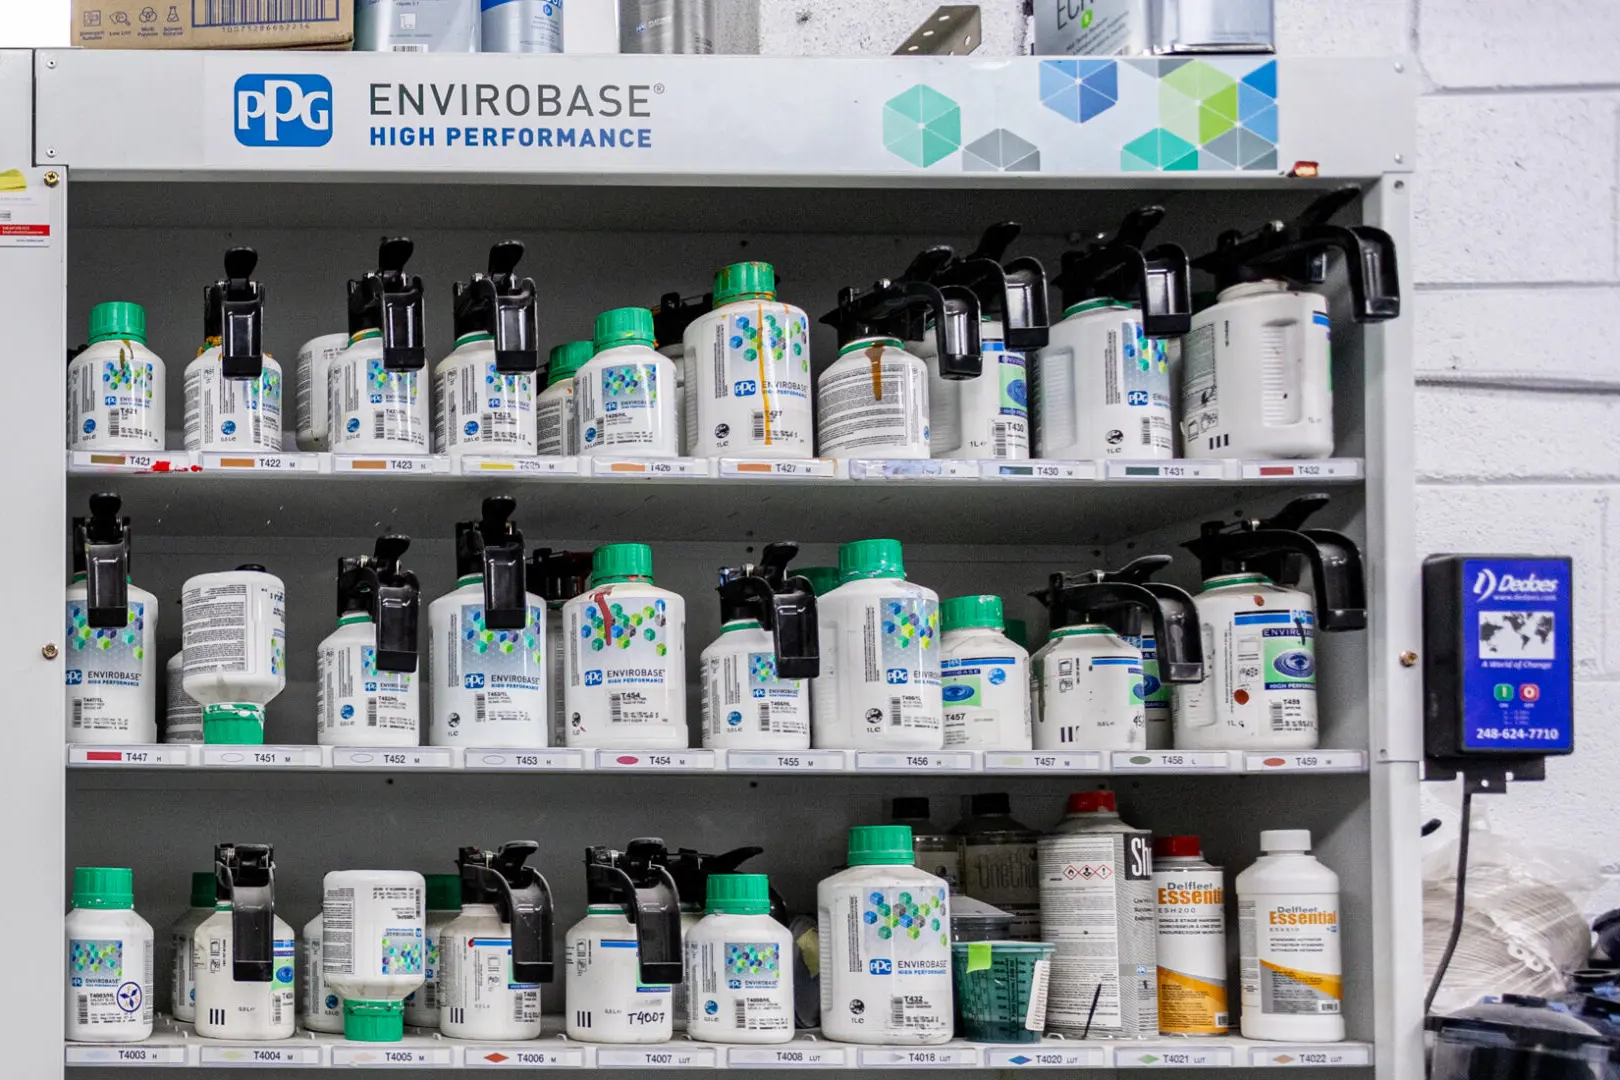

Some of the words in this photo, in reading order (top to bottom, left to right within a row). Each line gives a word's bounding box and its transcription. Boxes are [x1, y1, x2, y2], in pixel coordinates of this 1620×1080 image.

[237, 80, 329, 141] PPG
[370, 127, 435, 147] HIGH
[446, 127, 652, 149] PERFORMANCE
[129, 456, 151, 466] T421
[259, 458, 281, 468] T422
[391, 460, 412, 470] T423
[776, 464, 796, 472] T427
[1037, 466, 1059, 476] T430
[1164, 467, 1184, 476] T431
[1298, 466, 1319, 474] T432
[1498, 574, 1558, 592] Dedoes
[1477, 728, 1558, 740] 248-624-7710
[126, 753, 148, 761] T447
[254, 753, 275, 762] T451
[384, 755, 406, 763] T452
[516, 756, 537, 765] T453
[649, 756, 671, 765] T454
[778, 757, 799, 766] T455
[906, 757, 928, 766] T456
[1034, 757, 1056, 766] T457
[1162, 756, 1183, 764] T458
[1295, 757, 1317, 766] T459
[1168, 882, 1213, 890] Delfleet
[1269, 911, 1336, 925] Essential
[628, 1011, 665, 1025] T4007
[118, 1050, 146, 1060] T4003
[254, 1051, 280, 1060] T4004
[385, 1052, 412, 1061] T4005
[517, 1053, 544, 1063] T4006
[646, 1054, 672, 1063] T4007
[777, 1052, 804, 1062] T4008
[908, 1053, 936, 1062] T4018
[1164, 1055, 1190, 1063] T4021
[1300, 1054, 1327, 1063] T4022
[1036, 1055, 1062, 1065] T4020
